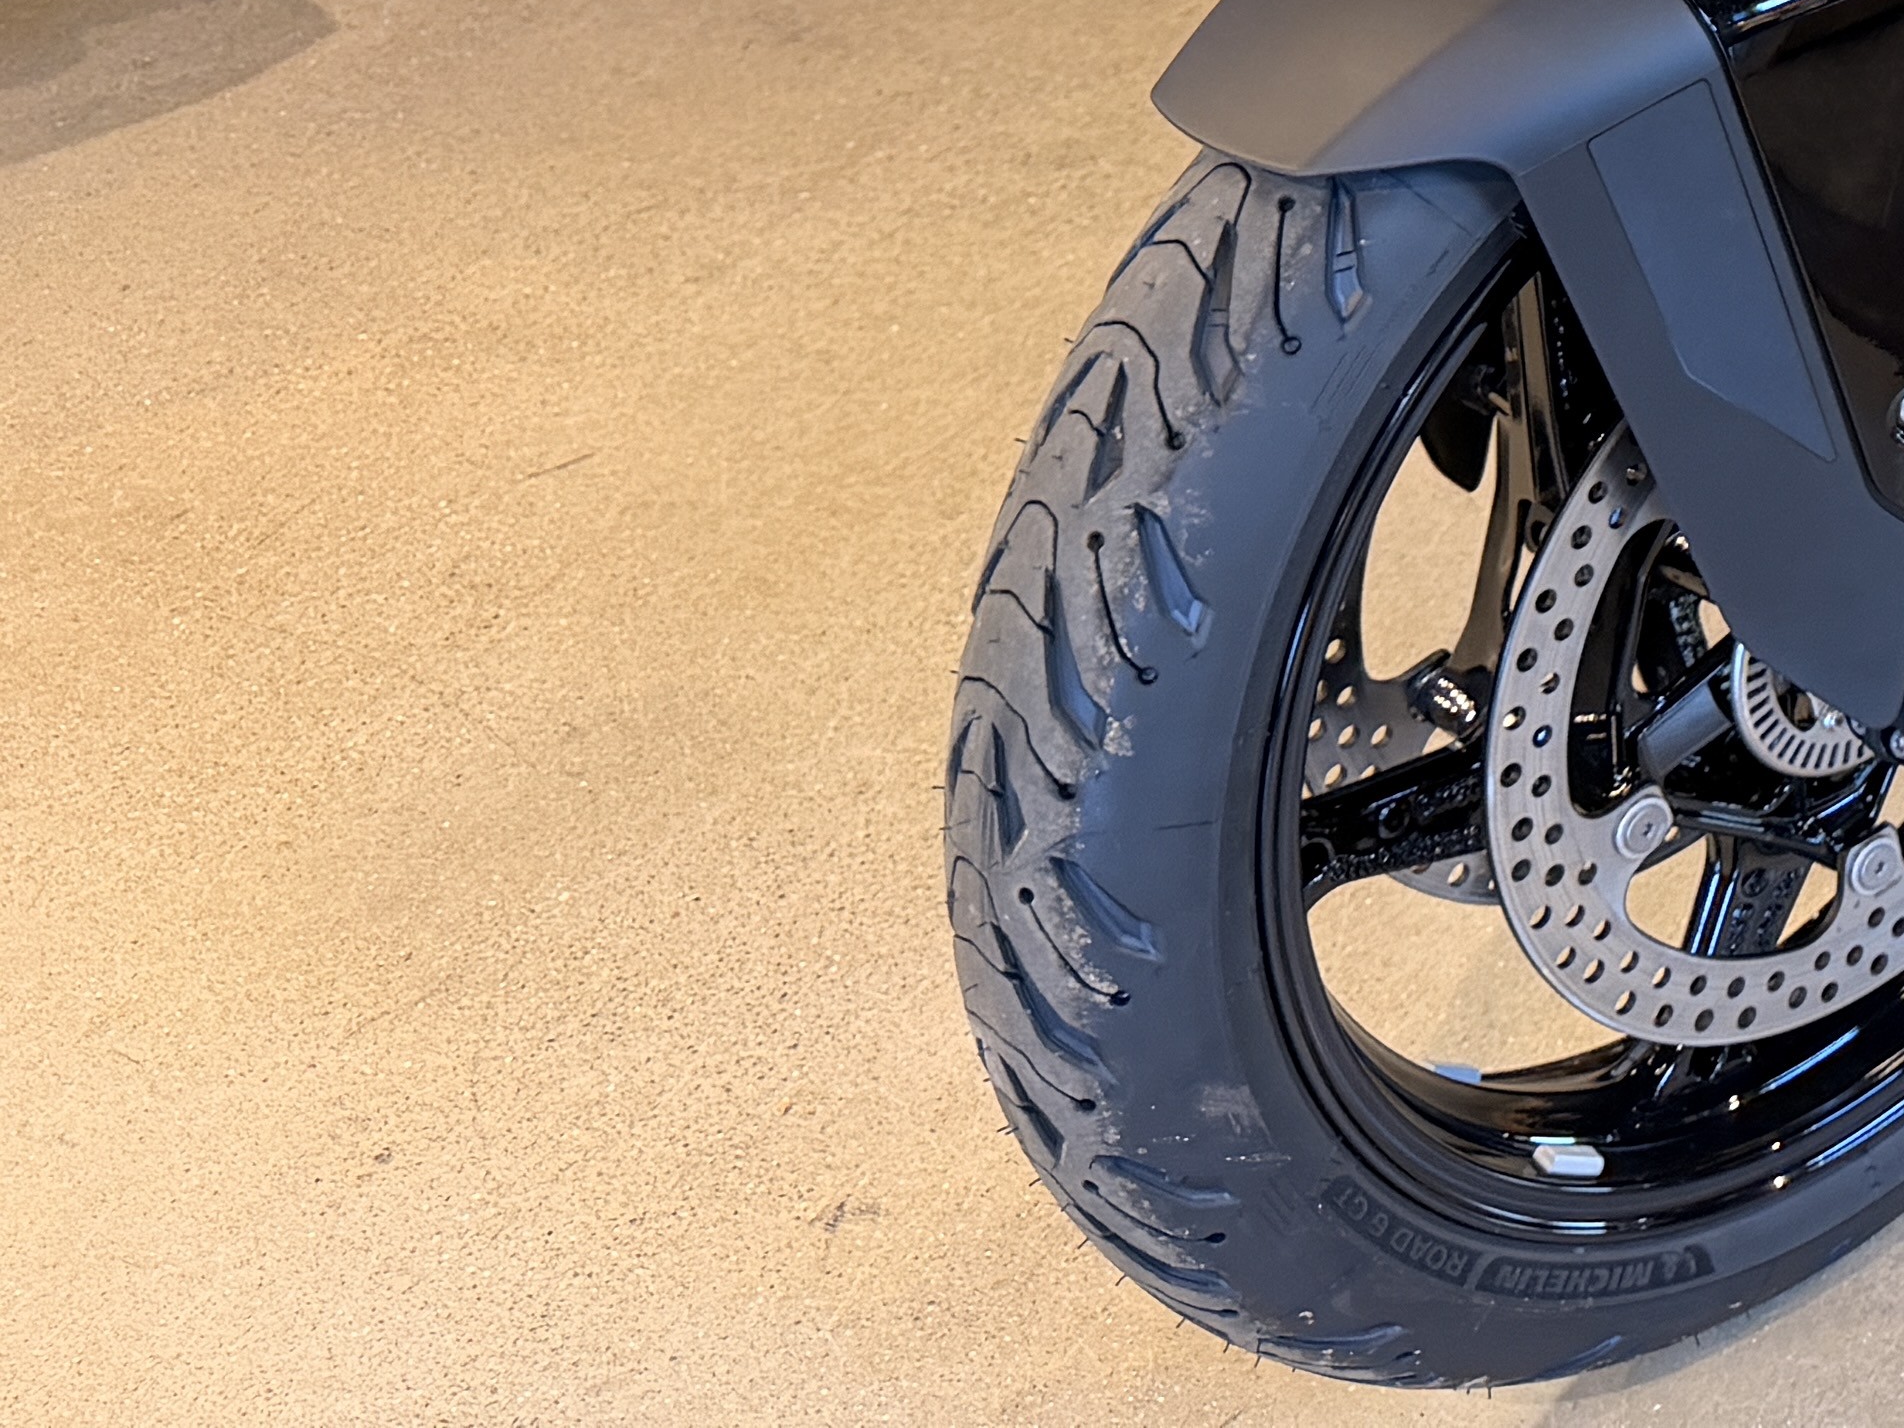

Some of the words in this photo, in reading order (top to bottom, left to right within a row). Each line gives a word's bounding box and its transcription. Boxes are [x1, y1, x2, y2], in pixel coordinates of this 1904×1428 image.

[1333, 1185, 1369, 1222] GT
[1388, 1229, 1469, 1278] ROAD
[1496, 1258, 1655, 1295] MICHELIN
